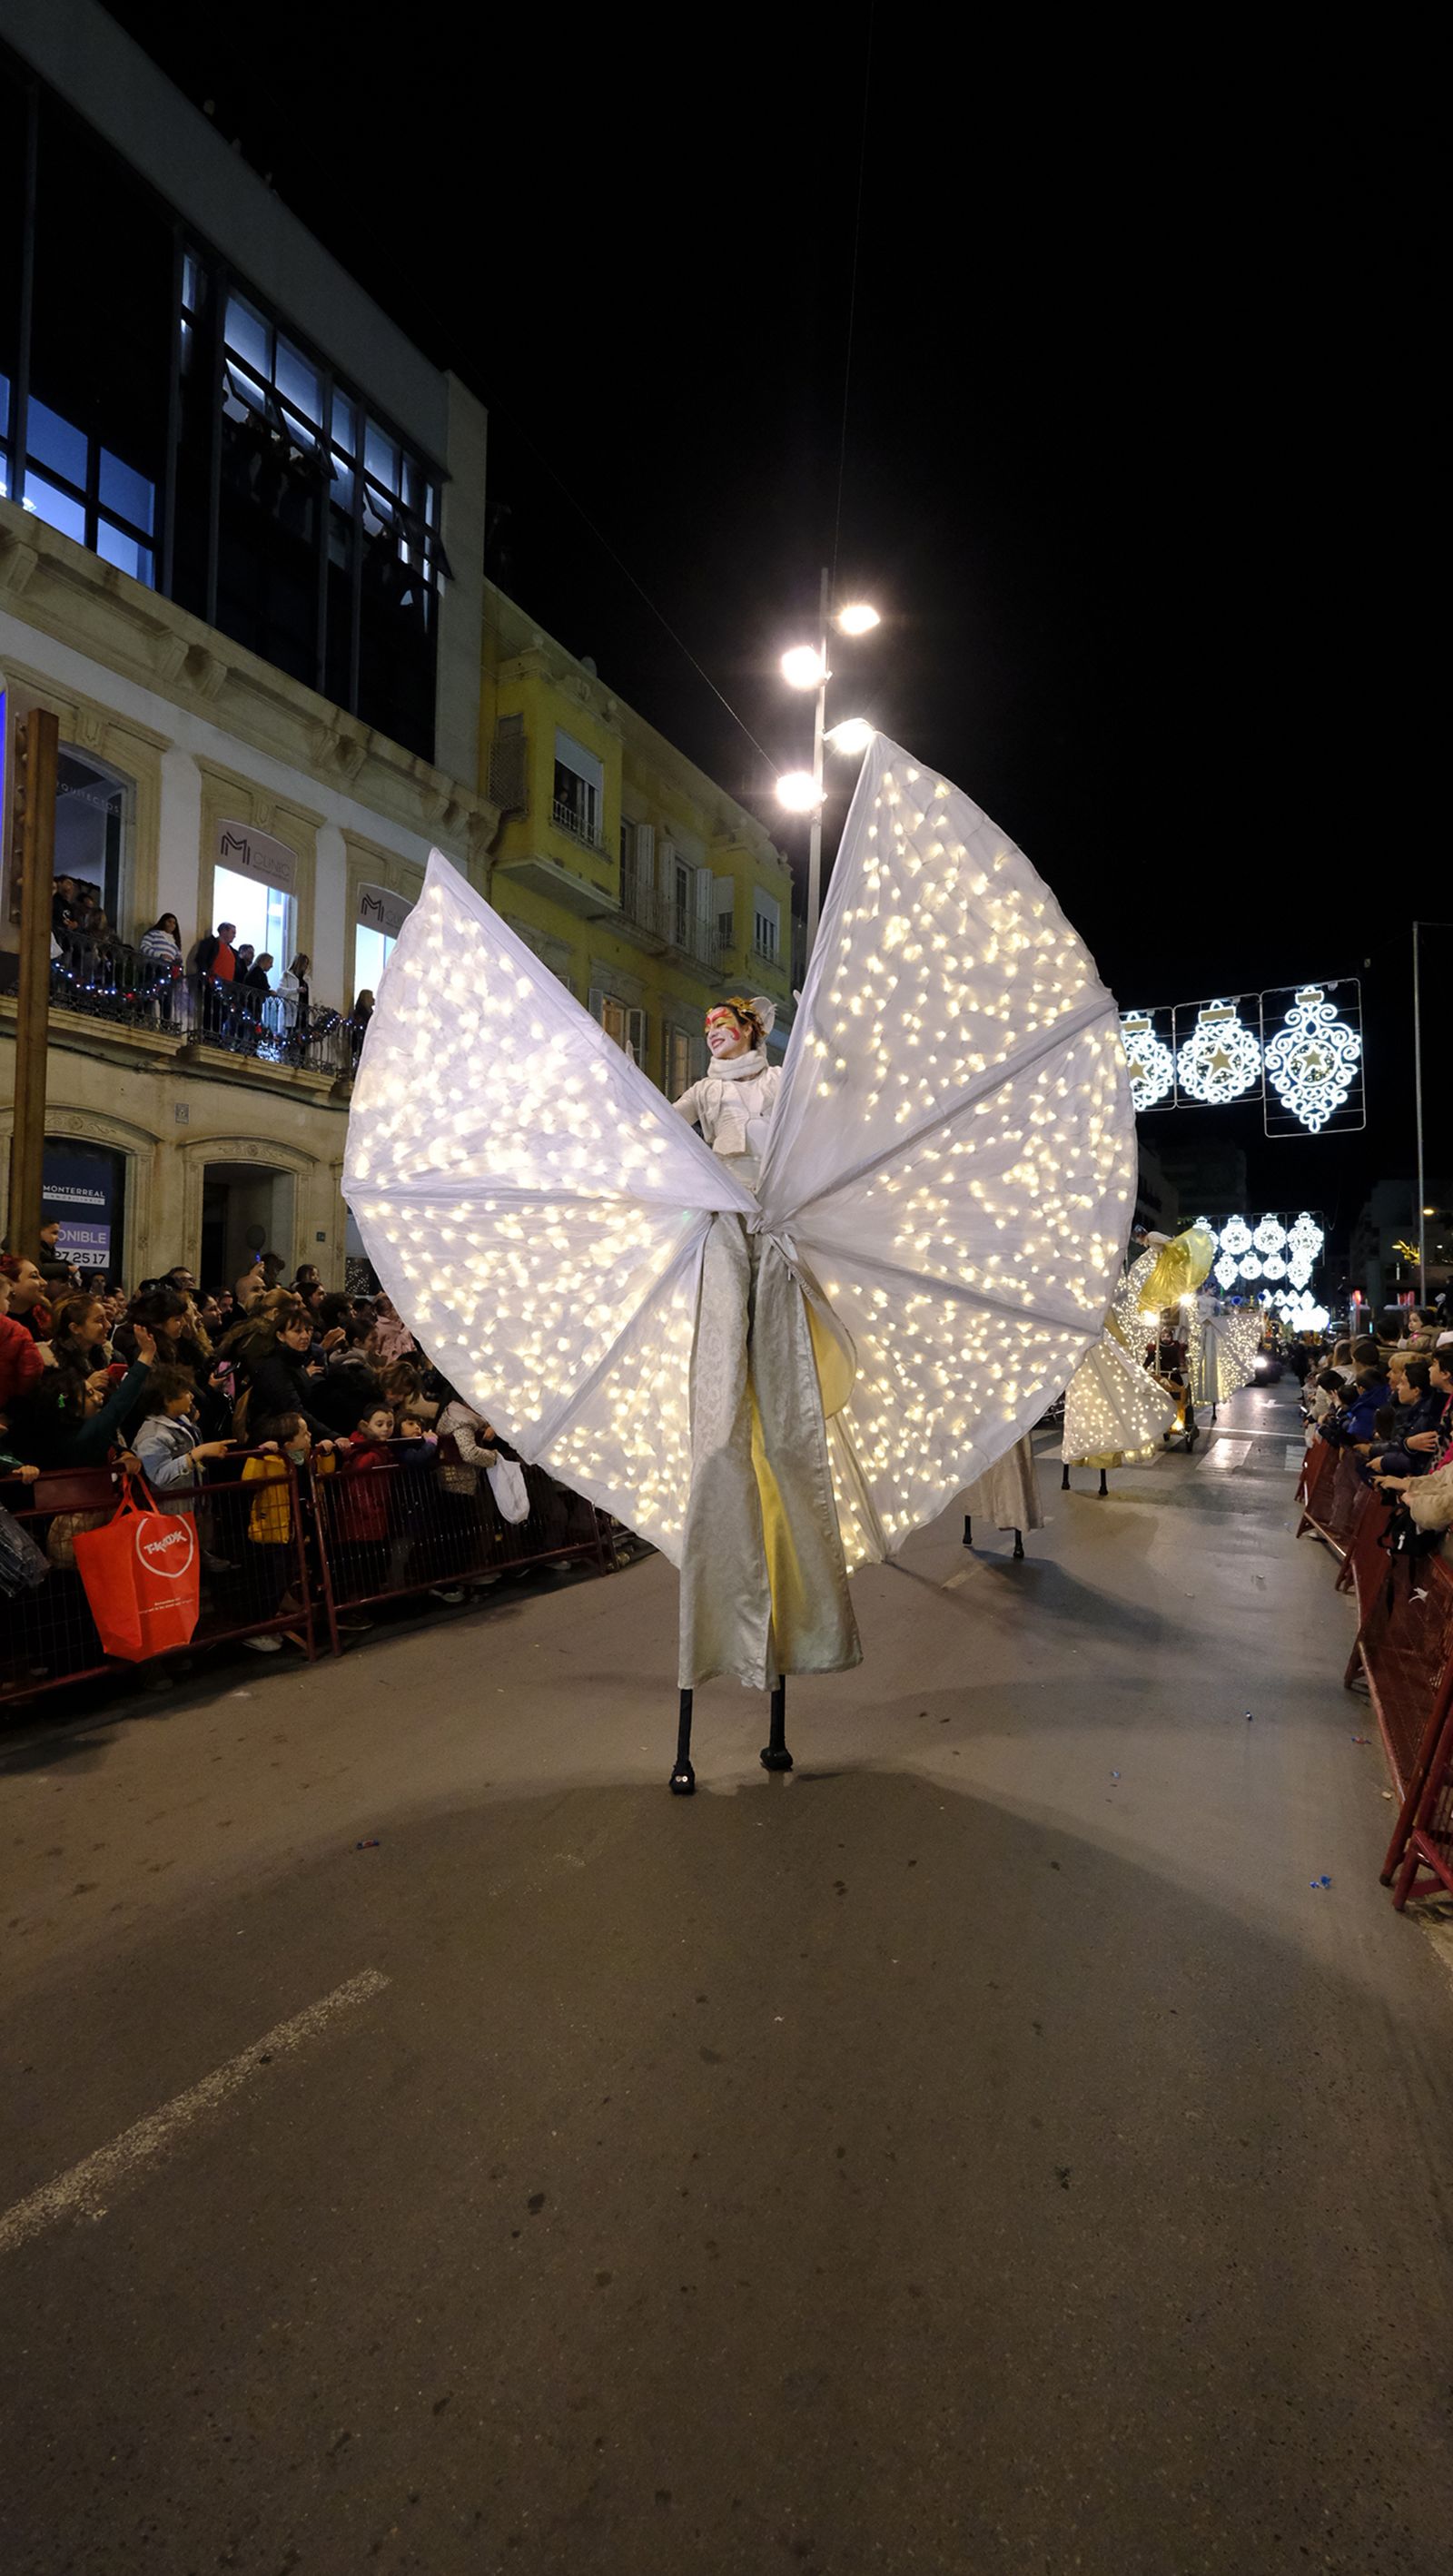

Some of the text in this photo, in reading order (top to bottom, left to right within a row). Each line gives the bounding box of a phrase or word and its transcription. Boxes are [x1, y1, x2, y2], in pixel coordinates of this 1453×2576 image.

[43, 1185, 105, 1198] MONTERREAL
[58, 1229, 106, 1244] ONIBLE
[73, 1252, 90, 1264] 25
[93, 1253, 106, 1265] 17
